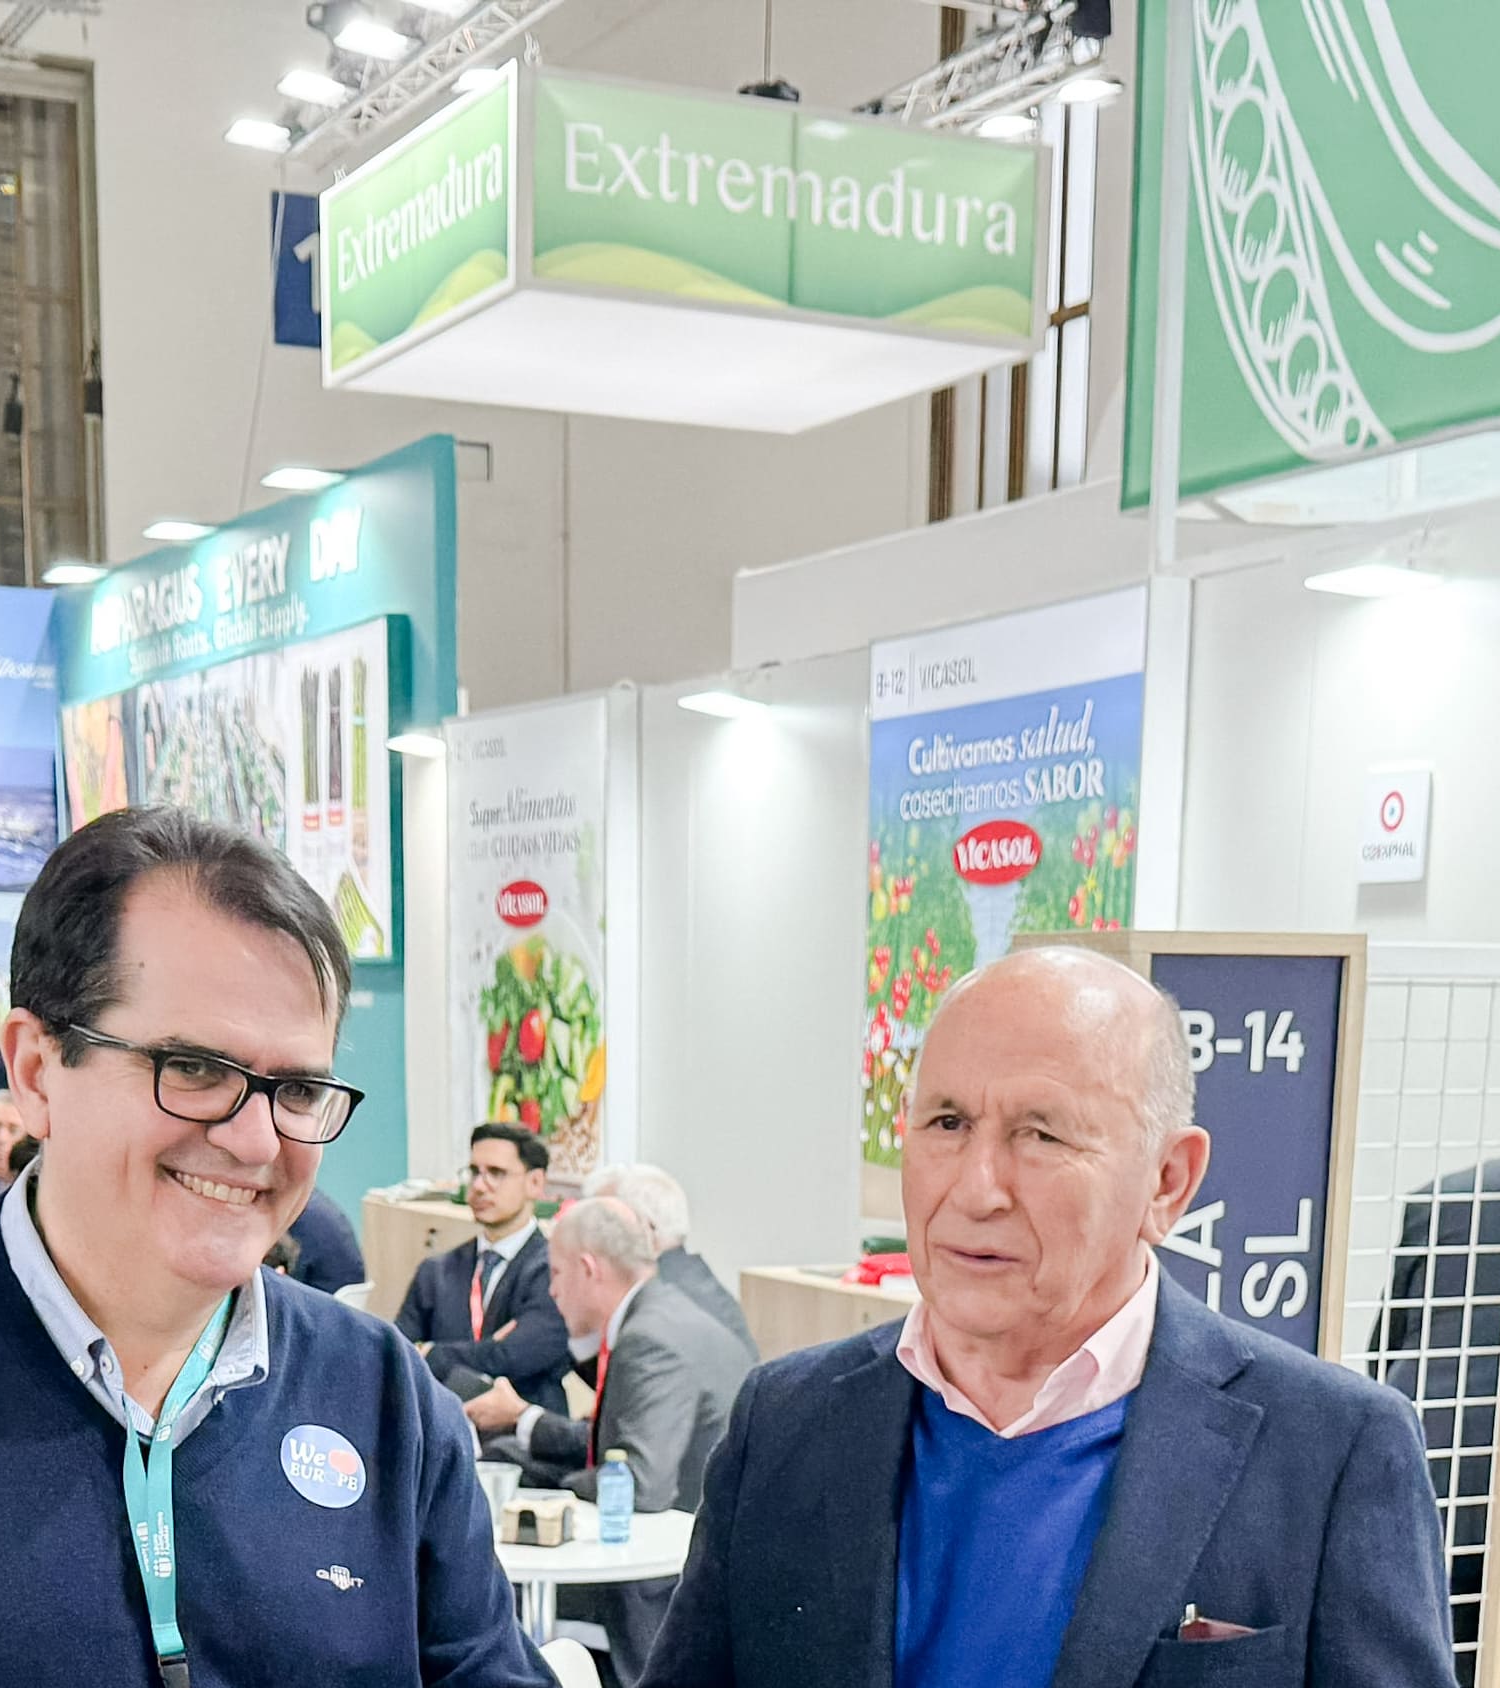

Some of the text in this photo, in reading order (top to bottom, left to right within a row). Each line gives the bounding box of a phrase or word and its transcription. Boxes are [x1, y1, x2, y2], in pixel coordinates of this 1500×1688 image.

[336, 140, 502, 294] Extremadura
[563, 121, 1017, 257] Extremadura
[918, 656, 978, 692] VICASOL
[908, 697, 1097, 775] Cultivamos salud,
[900, 758, 1105, 822] cosechamos SABOR
[955, 834, 1038, 872] VICASOL
[1180, 1008, 1305, 1073] B-14
[1240, 1198, 1313, 1319] SL
[289, 1437, 327, 1467] We
